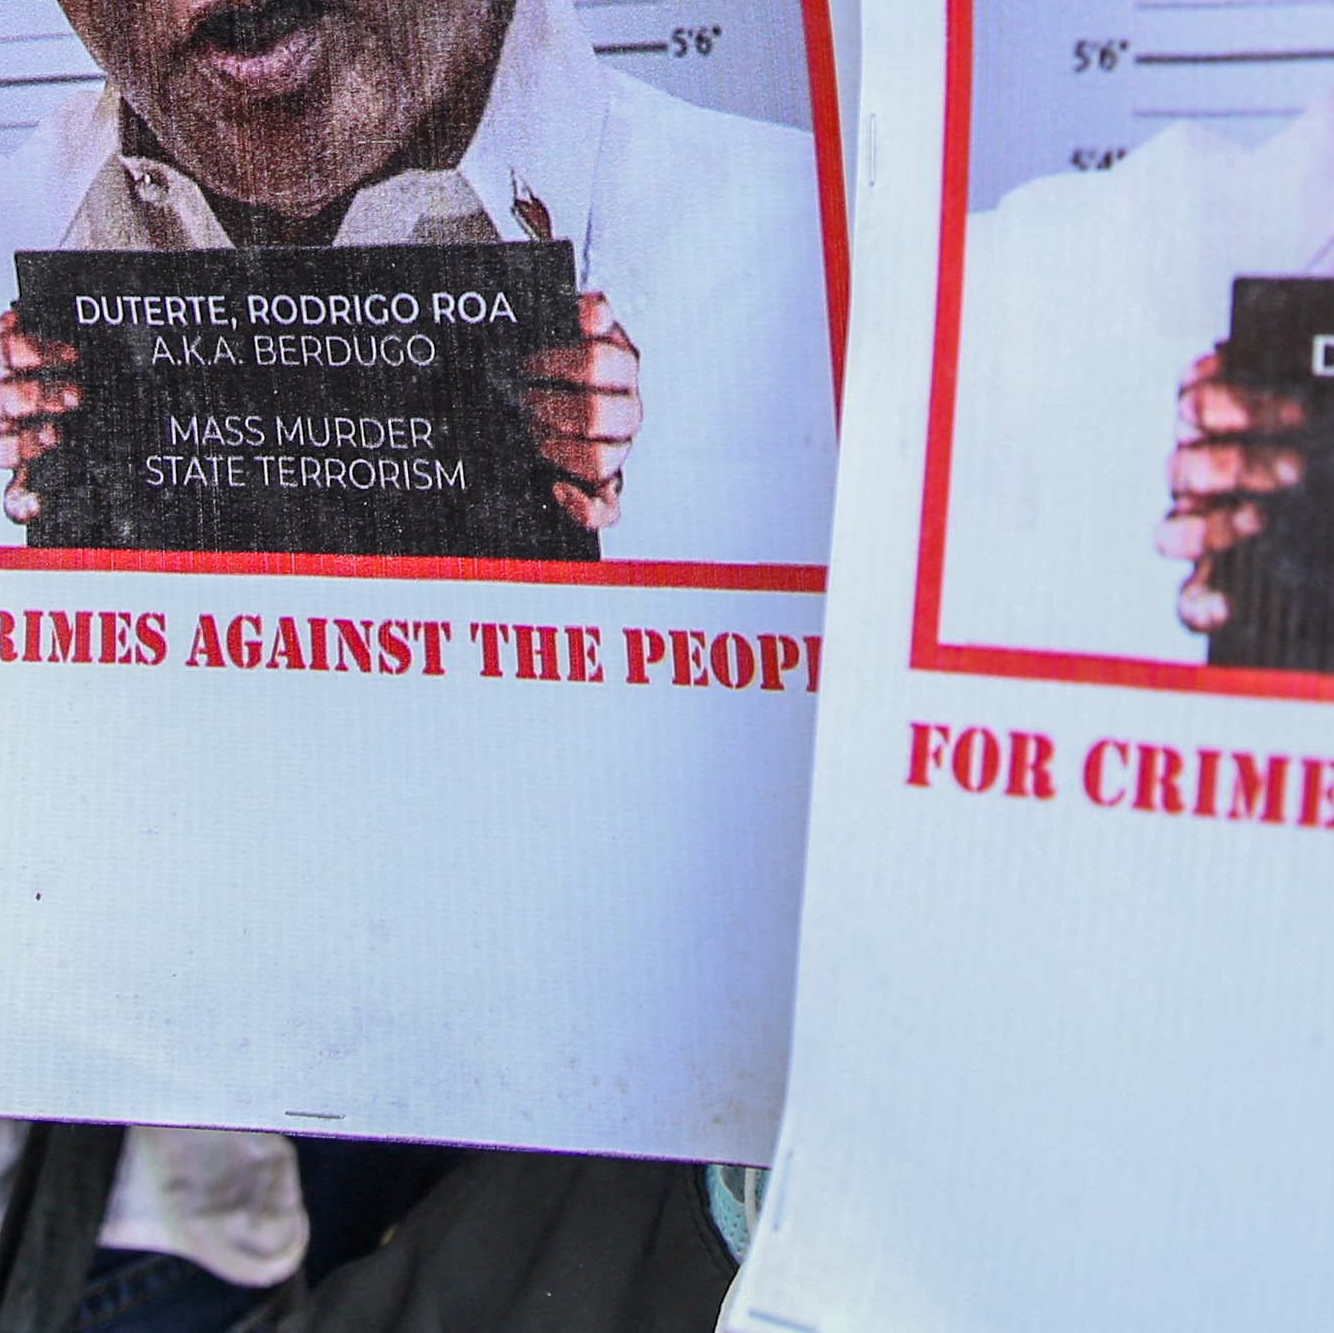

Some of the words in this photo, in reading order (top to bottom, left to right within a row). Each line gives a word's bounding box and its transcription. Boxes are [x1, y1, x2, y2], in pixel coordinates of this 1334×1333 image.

[76, 296, 236, 329] DUTERTE,
[248, 293, 419, 324] RODRIGO
[433, 292, 516, 323] ROA
[152, 336, 243, 365] A.K.A.
[254, 334, 435, 366] BERDUGO
[171, 416, 265, 445] MASS
[276, 416, 432, 449] MURDER
[146, 455, 245, 486] STATE
[257, 455, 467, 490] TERRORISM
[186, 614, 451, 675] AGAINST
[471, 622, 603, 682] THE
[906, 721, 1055, 800] FOR
